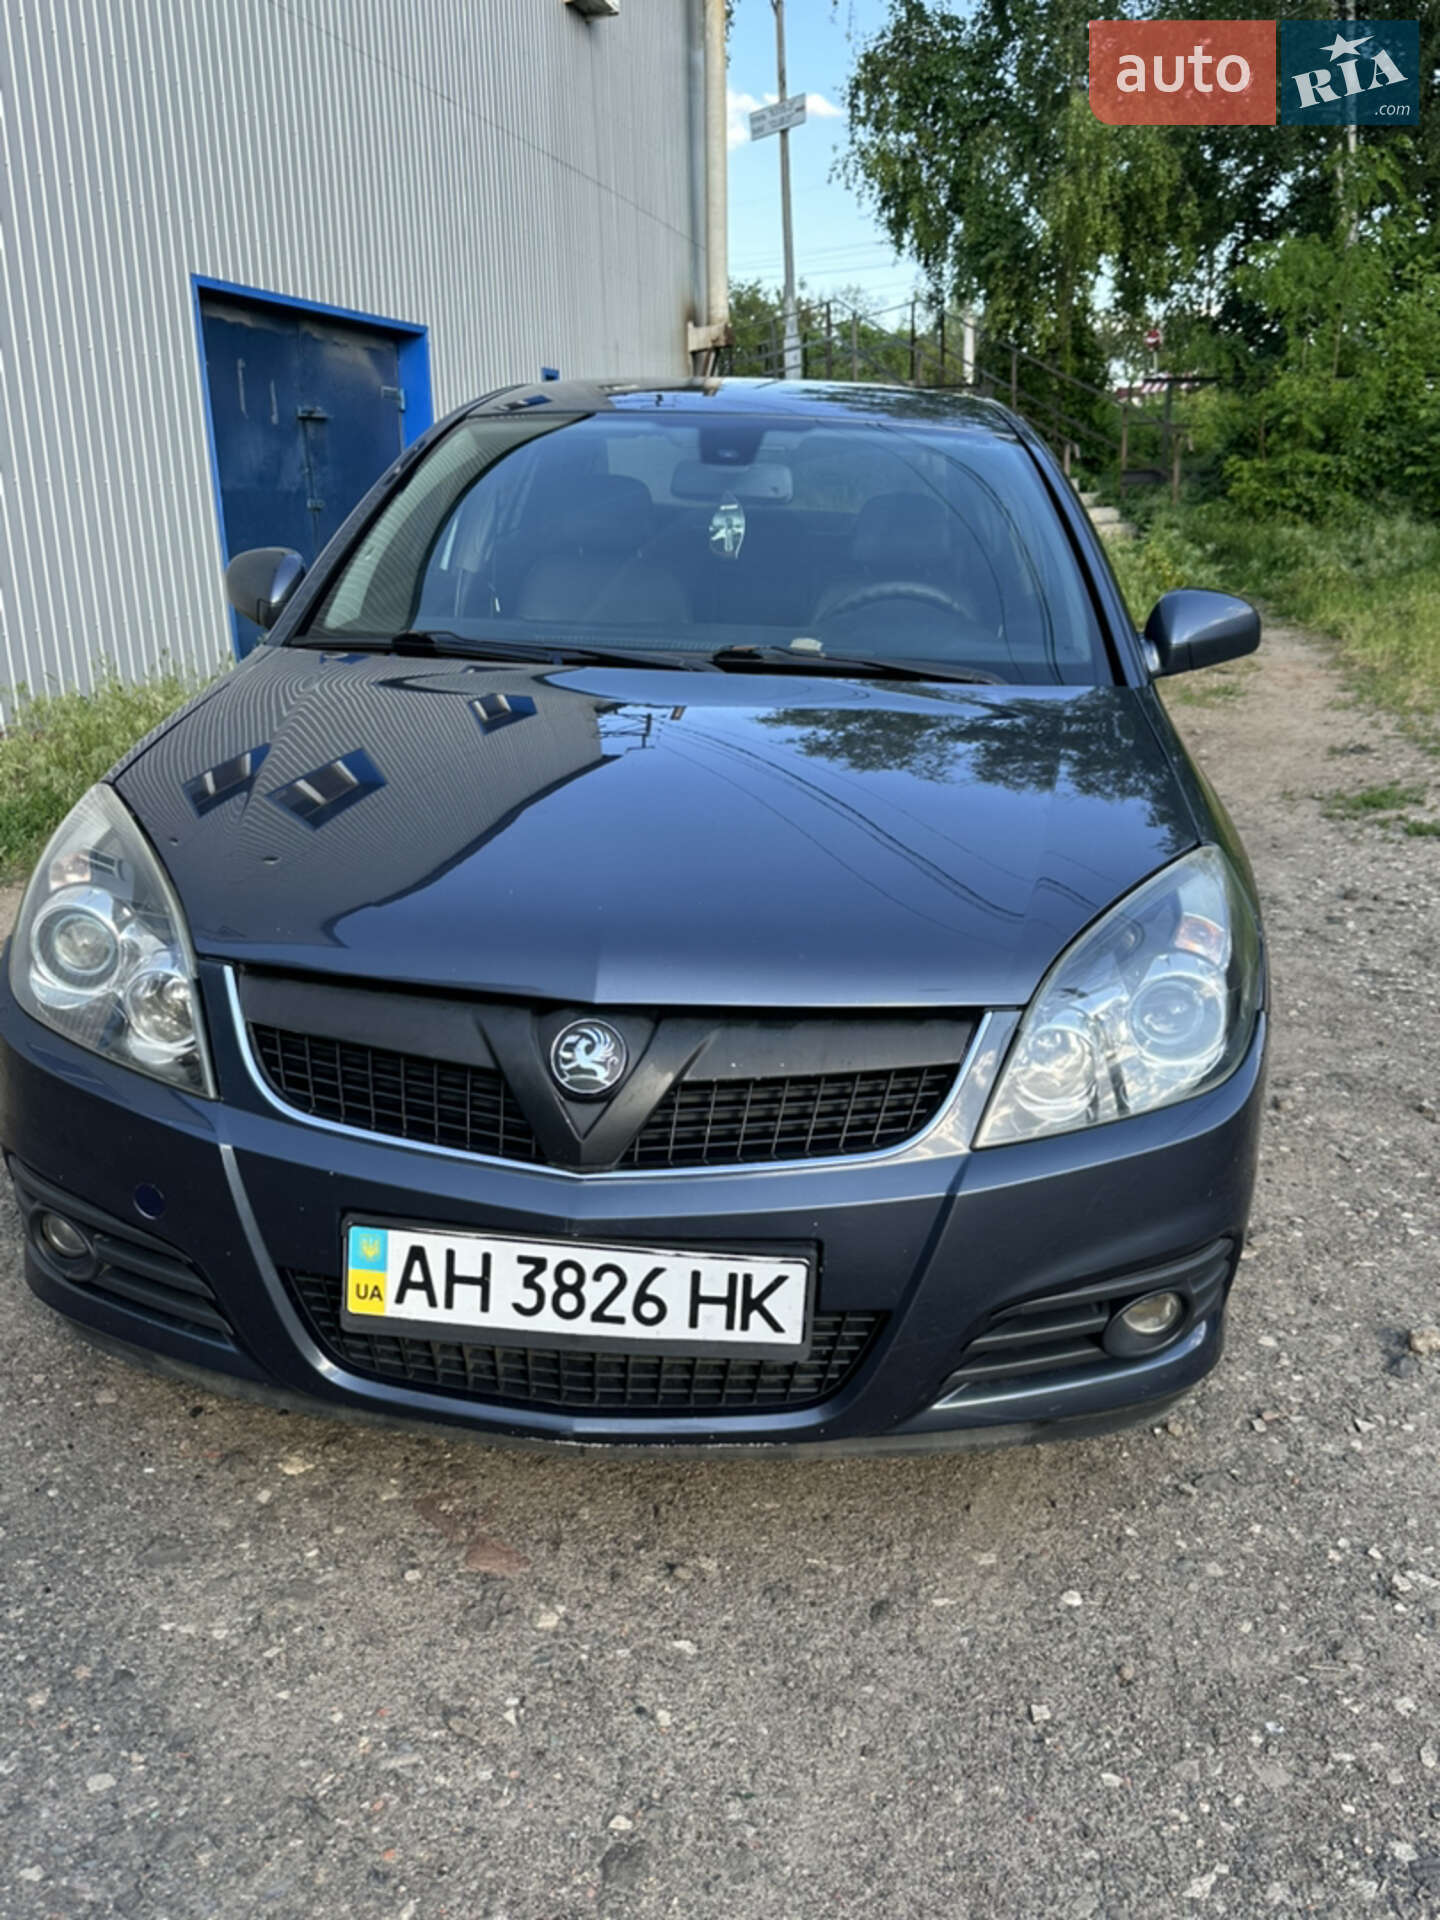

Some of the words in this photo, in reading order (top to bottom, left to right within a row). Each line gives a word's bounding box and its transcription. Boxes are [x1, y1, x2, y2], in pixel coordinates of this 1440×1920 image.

[355, 1283, 383, 1301] UA
[394, 1245, 491, 1313] AH
[511, 1255, 667, 1326] 3826
[689, 1269, 789, 1333] HK
